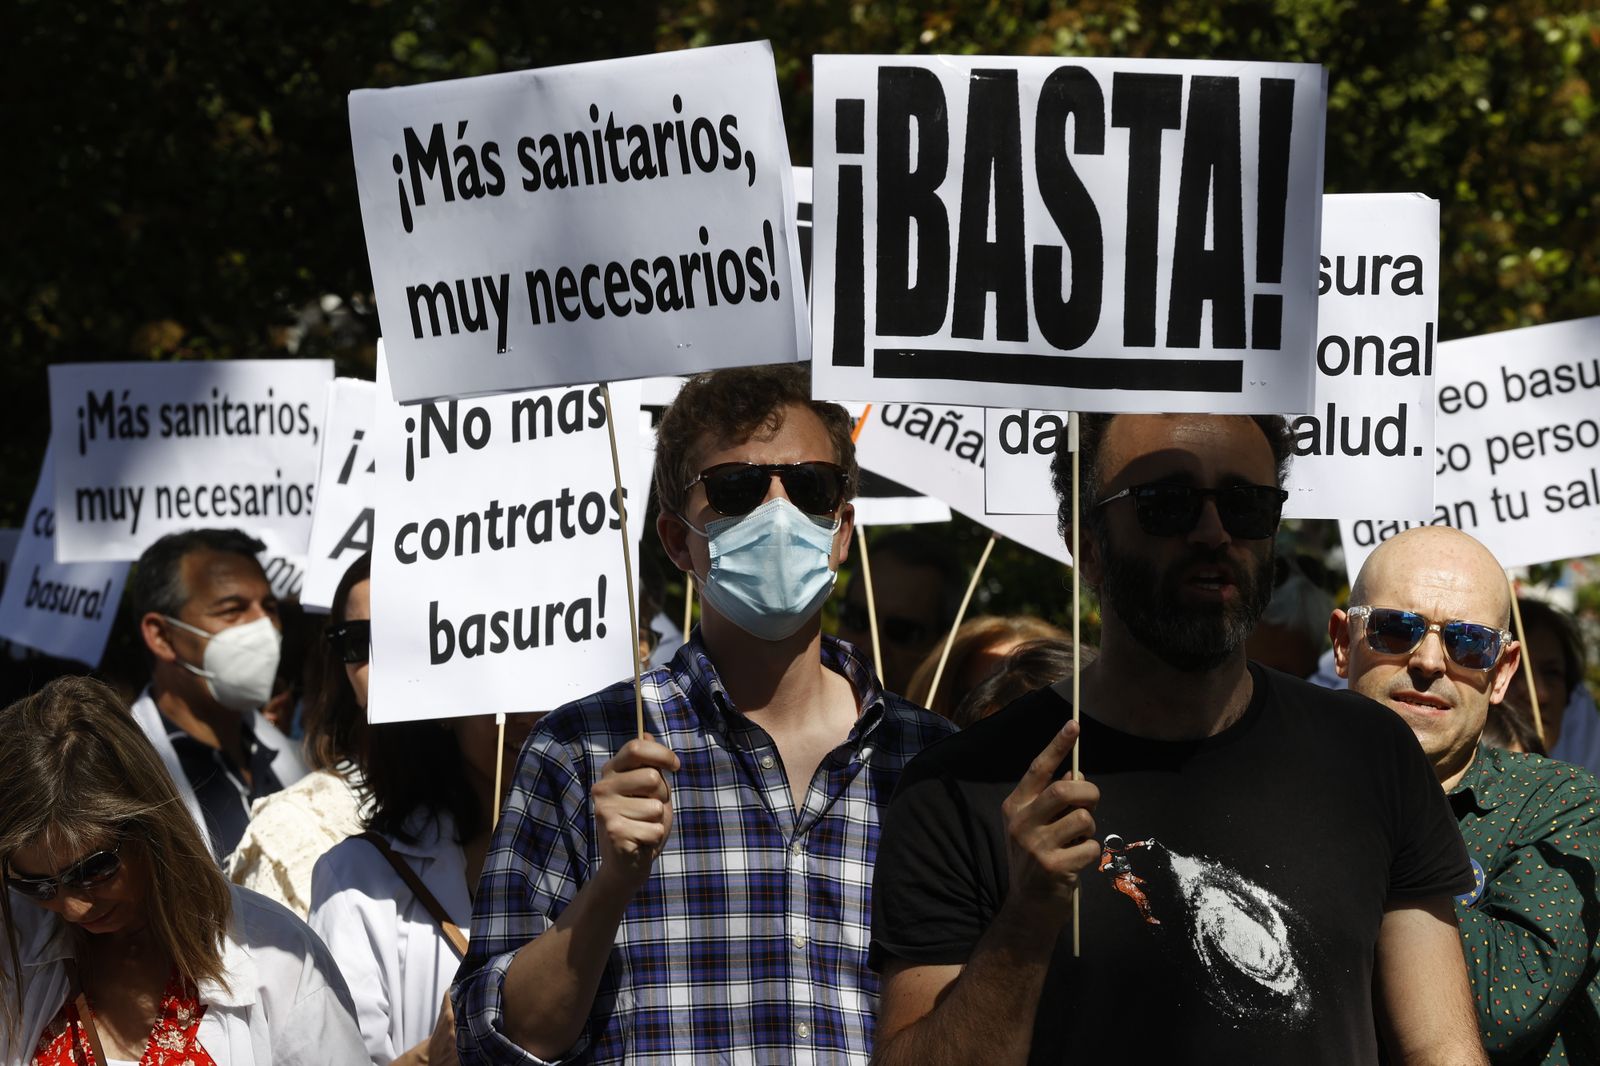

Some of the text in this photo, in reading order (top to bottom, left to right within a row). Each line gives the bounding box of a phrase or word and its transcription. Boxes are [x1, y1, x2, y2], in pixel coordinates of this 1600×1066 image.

[392, 94, 757, 234] ¡Más sanitarios,
[832, 65, 1295, 367] ¡BASTA!
[405, 273, 511, 355] muy
[525, 219, 780, 326] necesarios!
[1501, 358, 1600, 403] basu
[77, 387, 320, 456] ¡Más sanitarios,
[405, 399, 492, 482] ¡No
[880, 403, 985, 469] daña
[1485, 418, 1600, 476] perso
[76, 485, 145, 536] muy
[394, 486, 628, 565] contratos
[1491, 487, 1529, 523] tu
[24, 564, 112, 621] basura!
[428, 574, 608, 666] basura!
